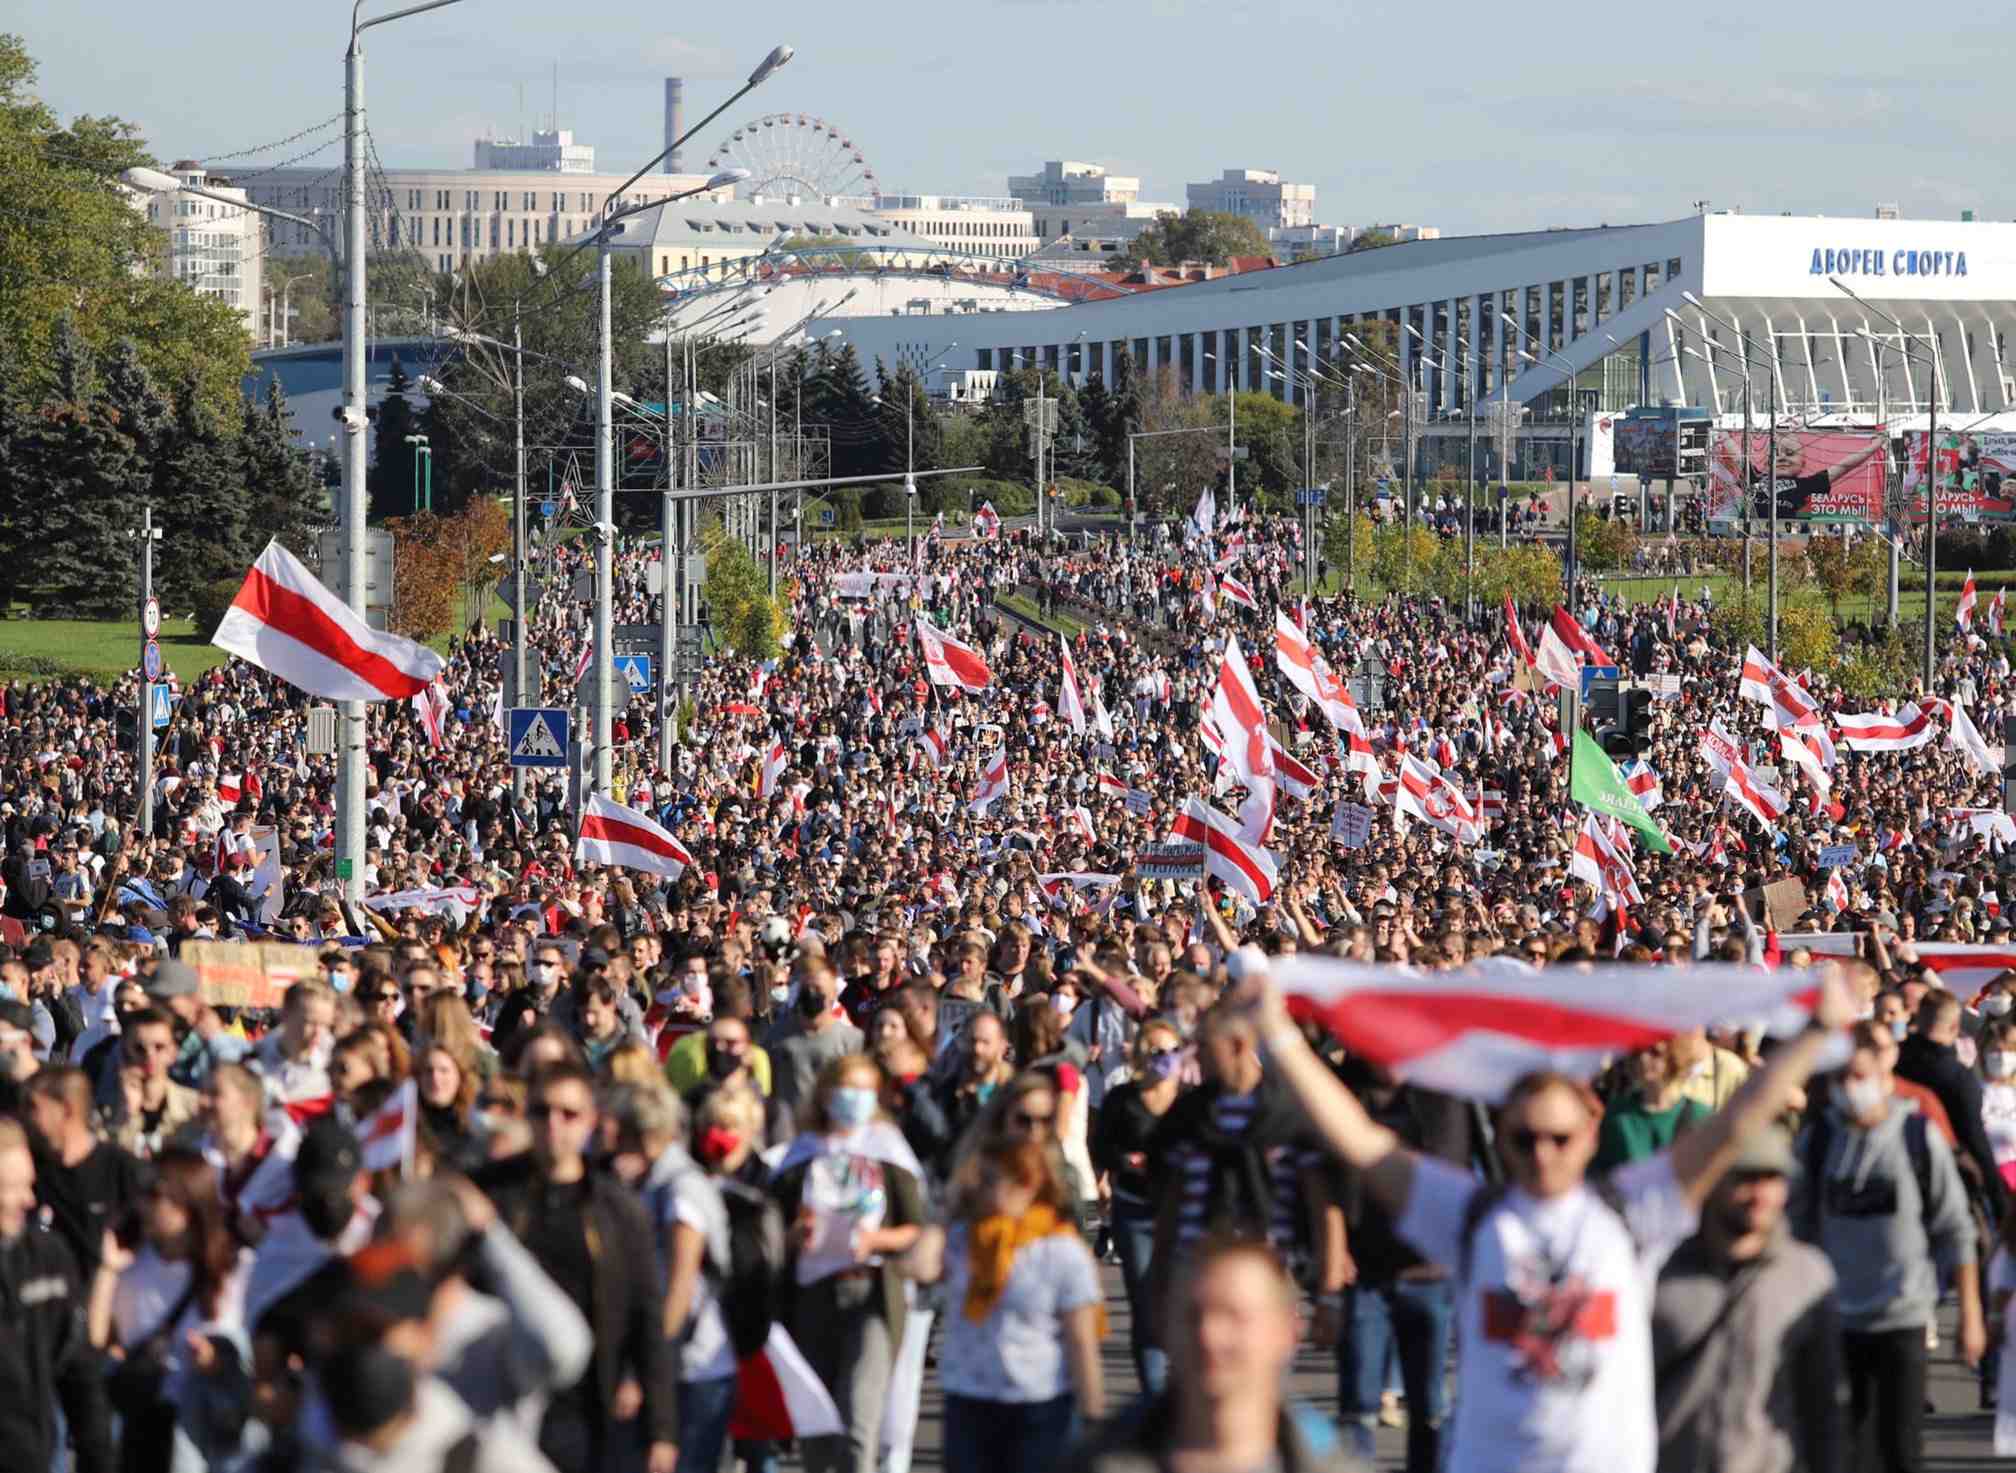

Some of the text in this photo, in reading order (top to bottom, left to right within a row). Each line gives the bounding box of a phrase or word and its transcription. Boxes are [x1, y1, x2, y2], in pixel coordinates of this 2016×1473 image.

[1809, 248, 1968, 277] ДВОРЕЦ СПОРТА
[1810, 493, 1865, 504] БЕЛАРУСЬ
[1810, 503, 1836, 514] ЭТО
[1920, 502, 1946, 513] ЭО
